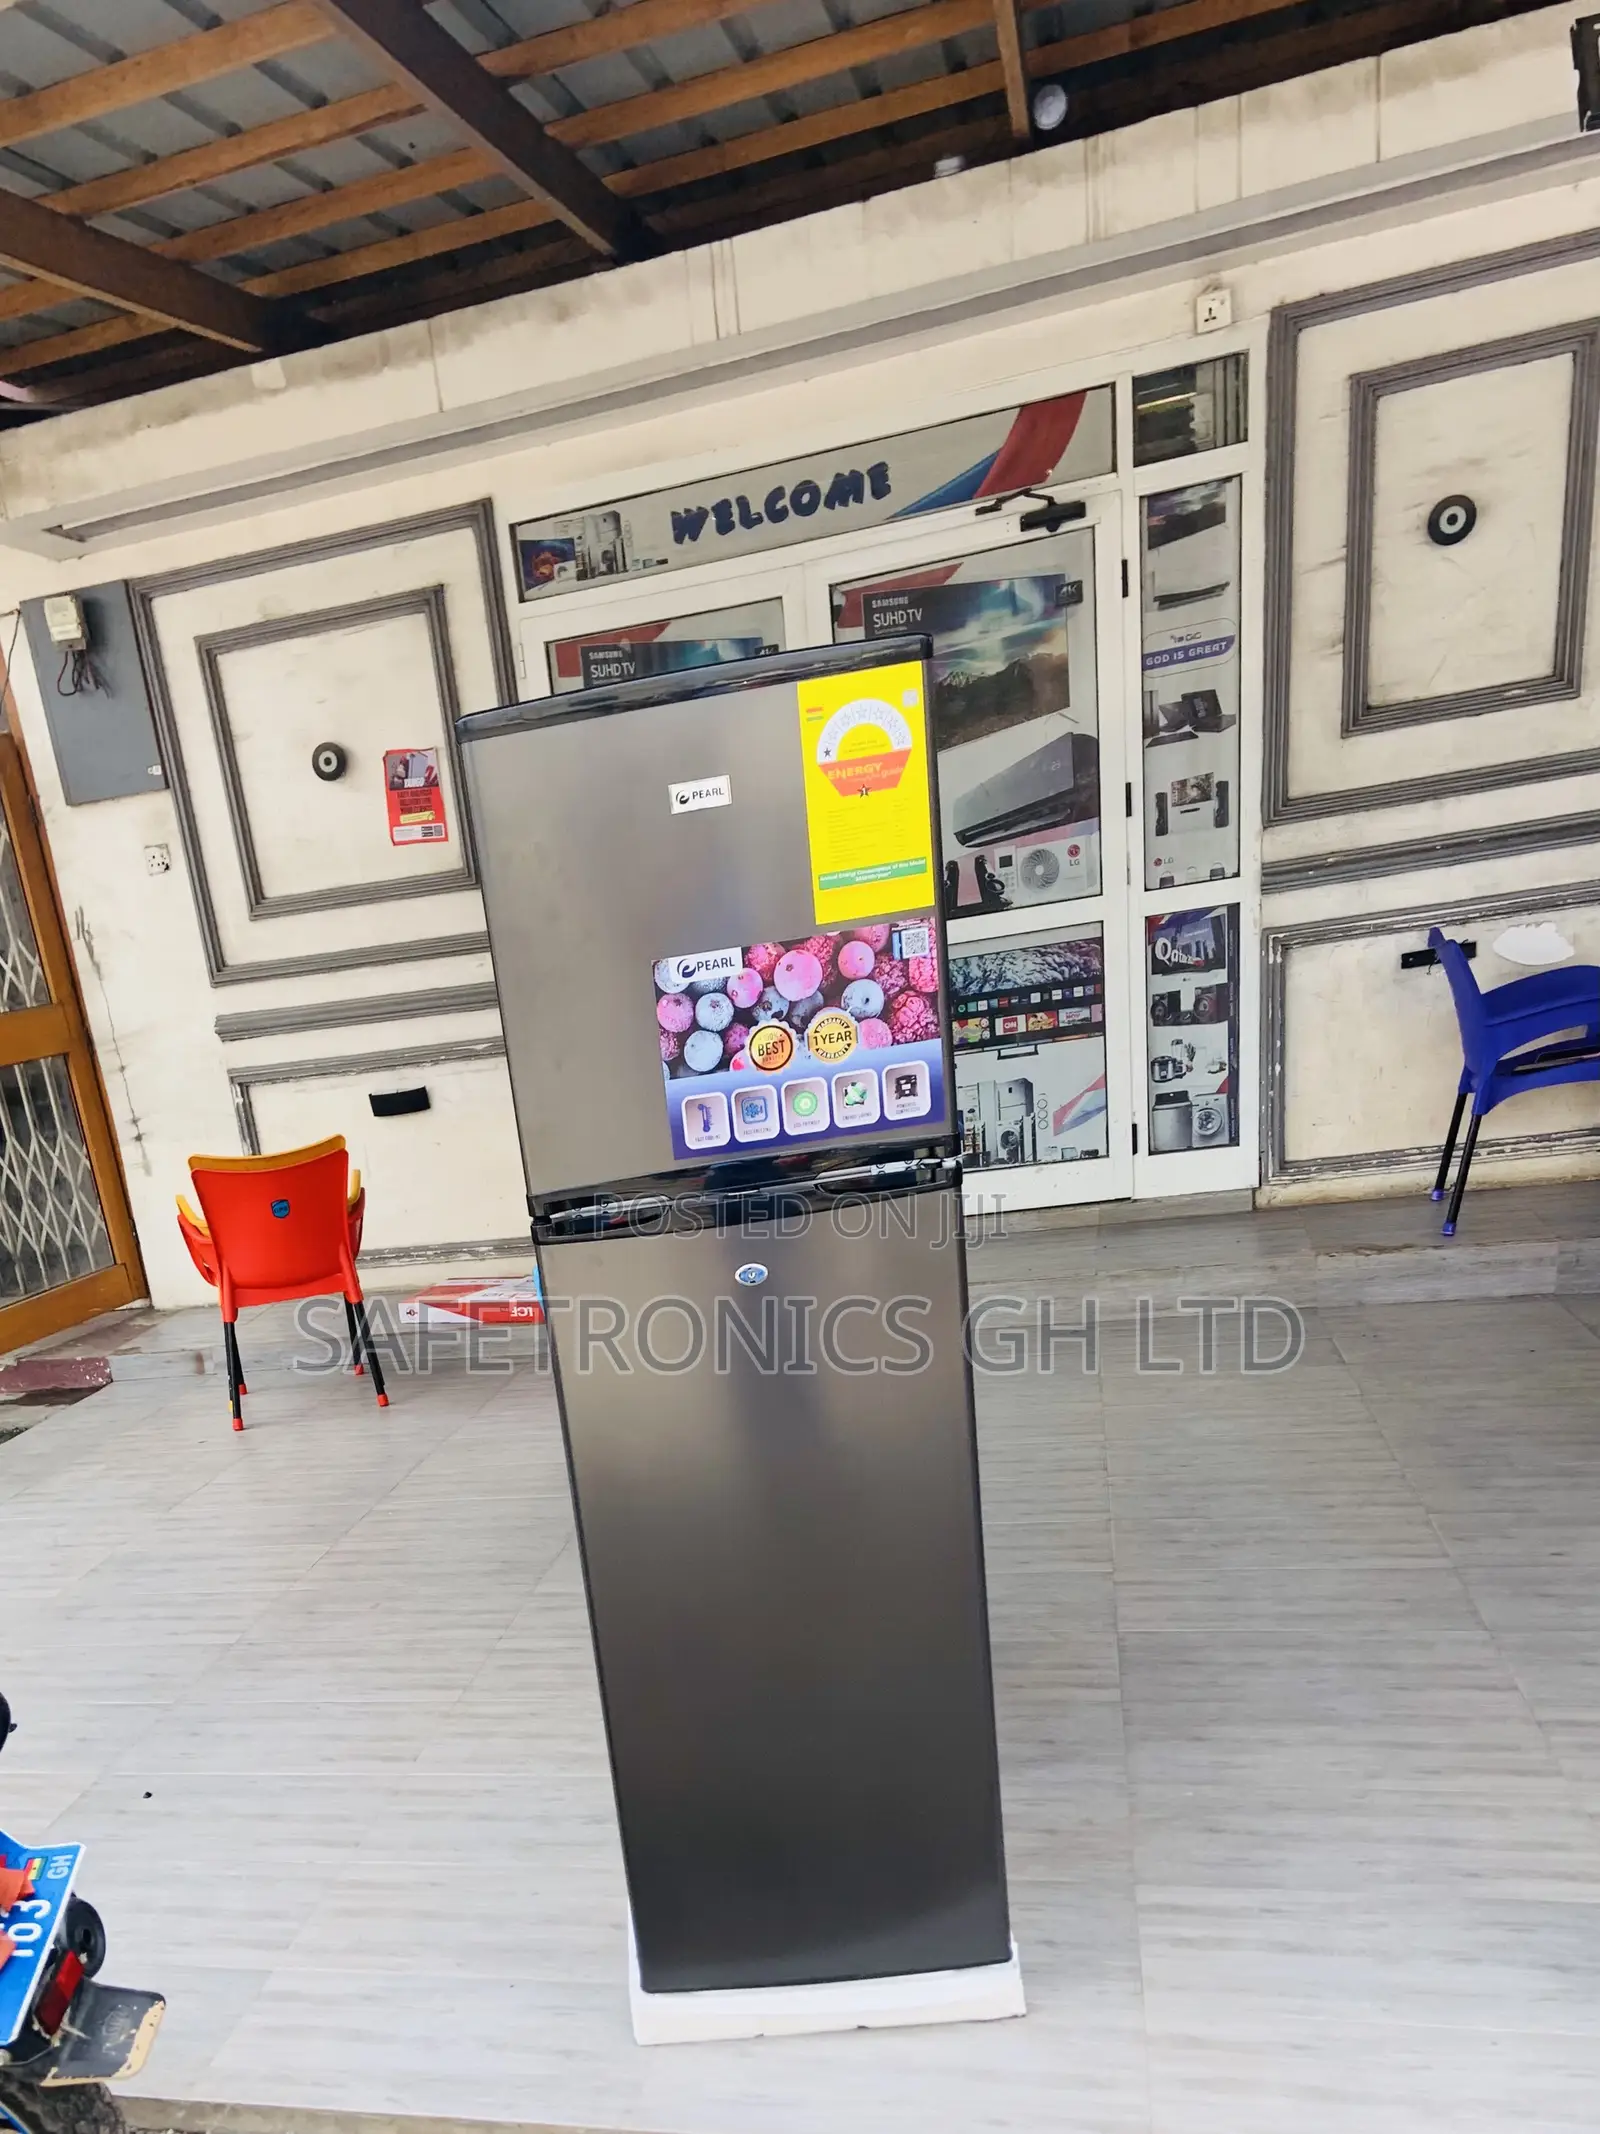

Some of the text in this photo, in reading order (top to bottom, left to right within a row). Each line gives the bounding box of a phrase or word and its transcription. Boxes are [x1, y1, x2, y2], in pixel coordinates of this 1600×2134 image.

[671, 461, 892, 544] WELCOME
[1059, 584, 1078, 598] 4K
[871, 596, 909, 609] SAMSUNG
[588, 650, 623, 661] SAMSUNG
[1145, 641, 1228, 666] GOD IS GREAT
[827, 762, 883, 780] ENERGY
[691, 786, 726, 801] PEARL
[1069, 858, 1081, 867] LG
[695, 956, 736, 976] PEARL
[812, 1030, 854, 1047] 1 YEAR
[757, 1039, 786, 1057] BEST
[46, 1853, 75, 1881] GH
